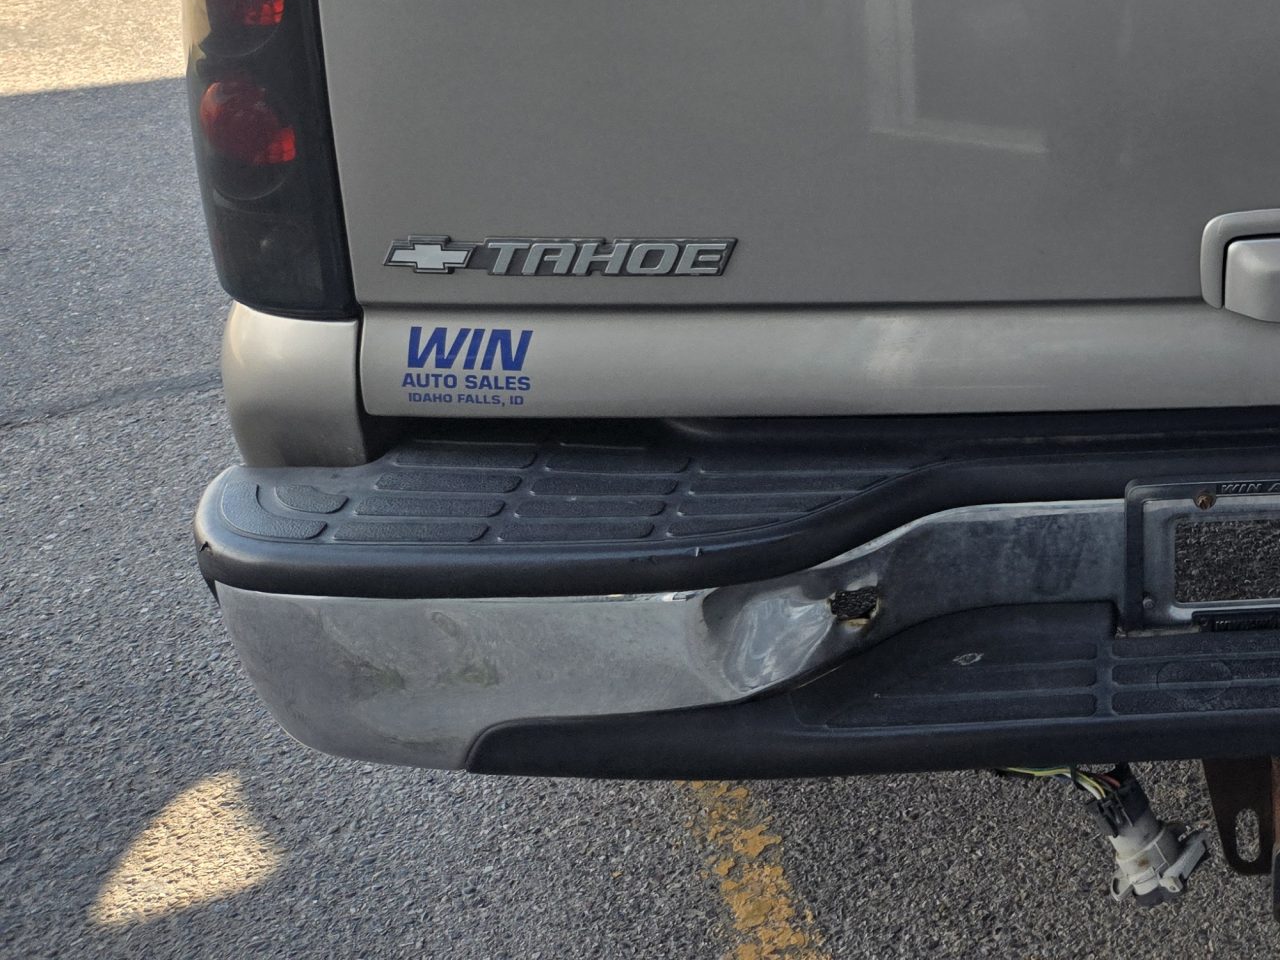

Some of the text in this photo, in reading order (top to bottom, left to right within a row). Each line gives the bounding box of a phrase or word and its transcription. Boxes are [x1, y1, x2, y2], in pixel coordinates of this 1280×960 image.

[485, 239, 735, 276] TAHOE
[406, 325, 534, 372] WIN
[402, 372, 531, 391] AUTO SALES
[408, 392, 524, 407] IDAHO FALLS, ID
[1220, 482, 1263, 494] WIN
